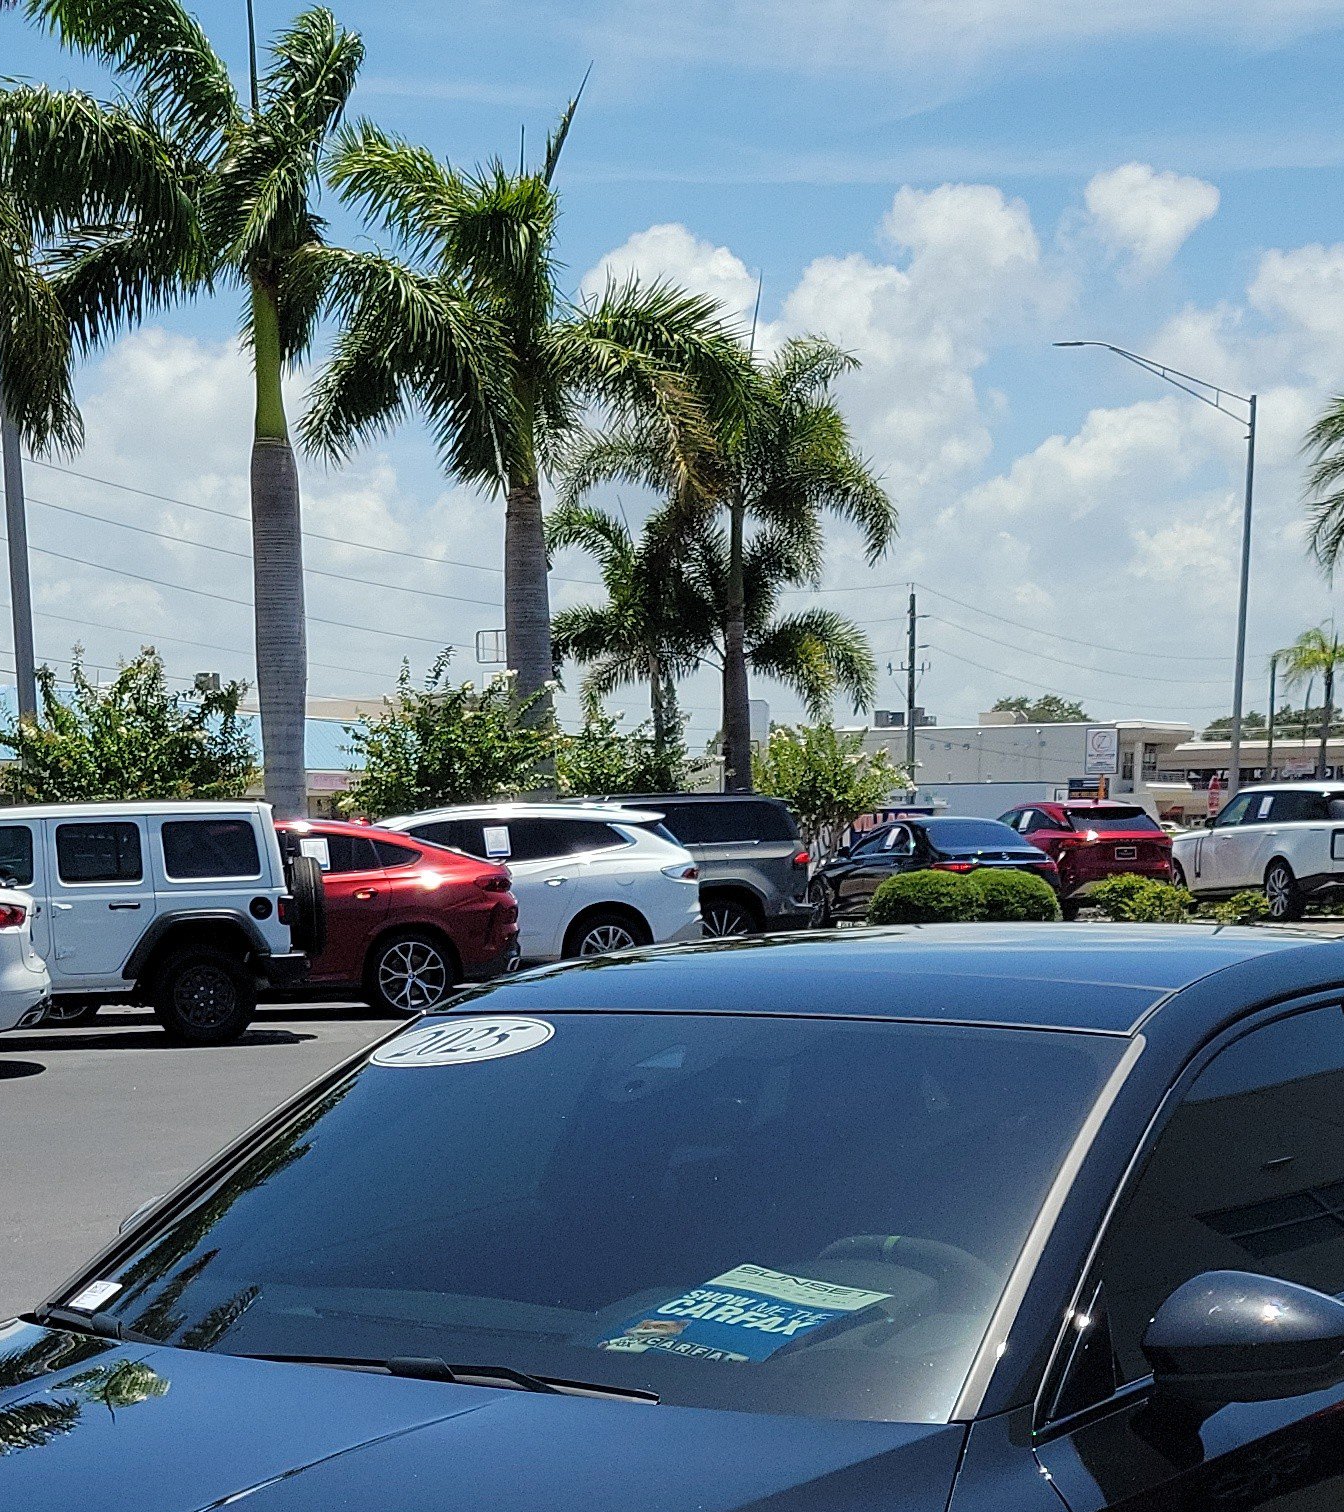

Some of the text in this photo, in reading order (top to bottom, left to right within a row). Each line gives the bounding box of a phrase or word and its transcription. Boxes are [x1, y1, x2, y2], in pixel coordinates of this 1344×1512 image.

[385, 1026, 533, 1059] 2025
[736, 1266, 881, 1298] SUNSET
[657, 1299, 816, 1336] CARFAX
[683, 1290, 757, 1307] SHOW
[750, 1302, 792, 1316] ME
[788, 1309, 834, 1324] THE
[646, 1336, 727, 1362] CARFA
